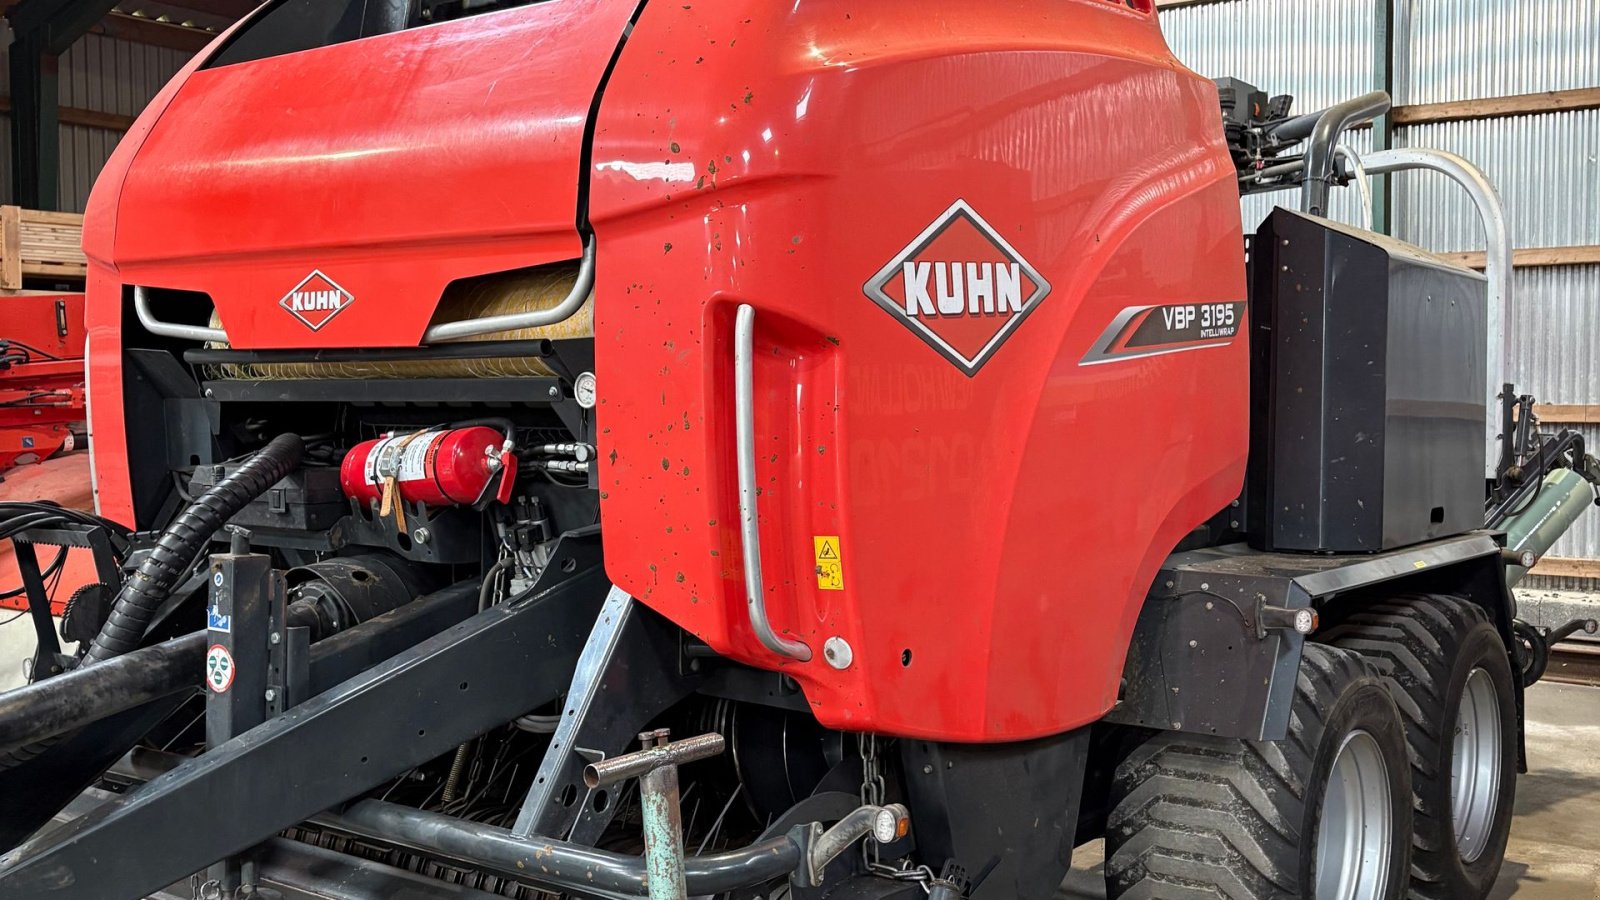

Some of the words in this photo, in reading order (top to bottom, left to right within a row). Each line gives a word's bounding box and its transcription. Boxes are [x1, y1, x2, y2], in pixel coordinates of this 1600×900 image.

[292, 290, 341, 312] KUHN
[903, 261, 1022, 316] KUHN
[1162, 305, 1196, 331] VBP
[1201, 303, 1235, 328] 3195
[1200, 327, 1235, 338] INTELLIWRAP
